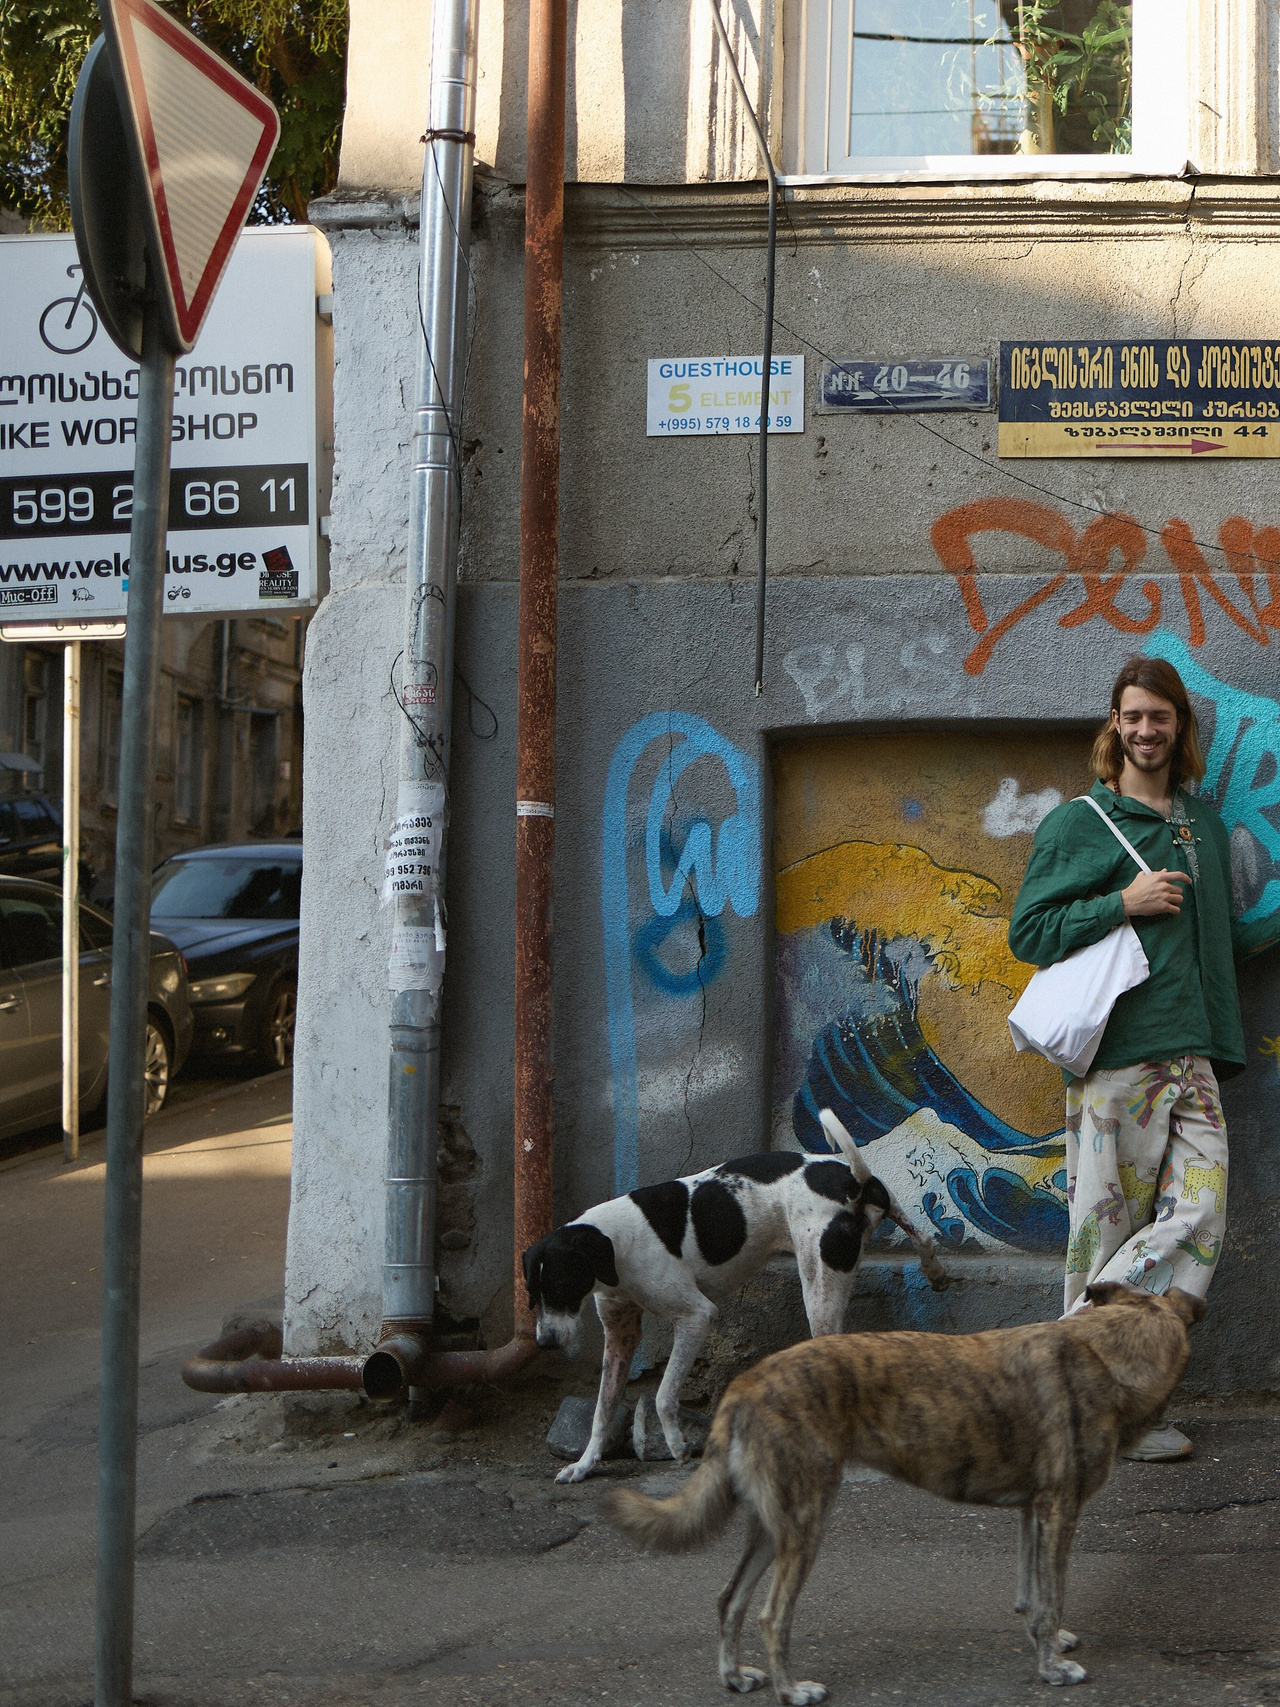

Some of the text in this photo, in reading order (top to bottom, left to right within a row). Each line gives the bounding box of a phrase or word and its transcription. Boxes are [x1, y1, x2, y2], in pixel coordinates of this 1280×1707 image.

[659, 361, 792, 378] GUESTHOUSE
[1010, 346, 1114, 389] ინგლისური
[1120, 346, 1159, 388] ენის
[1166, 345, 1191, 388] და
[667, 382, 792, 413] 5 ELEMENT
[1048, 400, 1194, 418] შემსწავლელი
[61, 411, 258, 447] WORSHOP
[658, 417, 701, 431] +(995)
[705, 417, 730, 428] 579
[735, 416, 750, 428] 18
[775, 415, 792, 427] 59
[1063, 425, 1269, 437] ზუბალაშვილი 44
[12, 487, 95, 526] 599
[184, 480, 240, 517] 66
[260, 477, 296, 512] 11
[0, 550, 257, 583] ww.vellus.ge
[1, 587, 55, 603] Muc-Off
[397, 864, 415, 875] 952
[392, 880, 424, 891] ომარი
